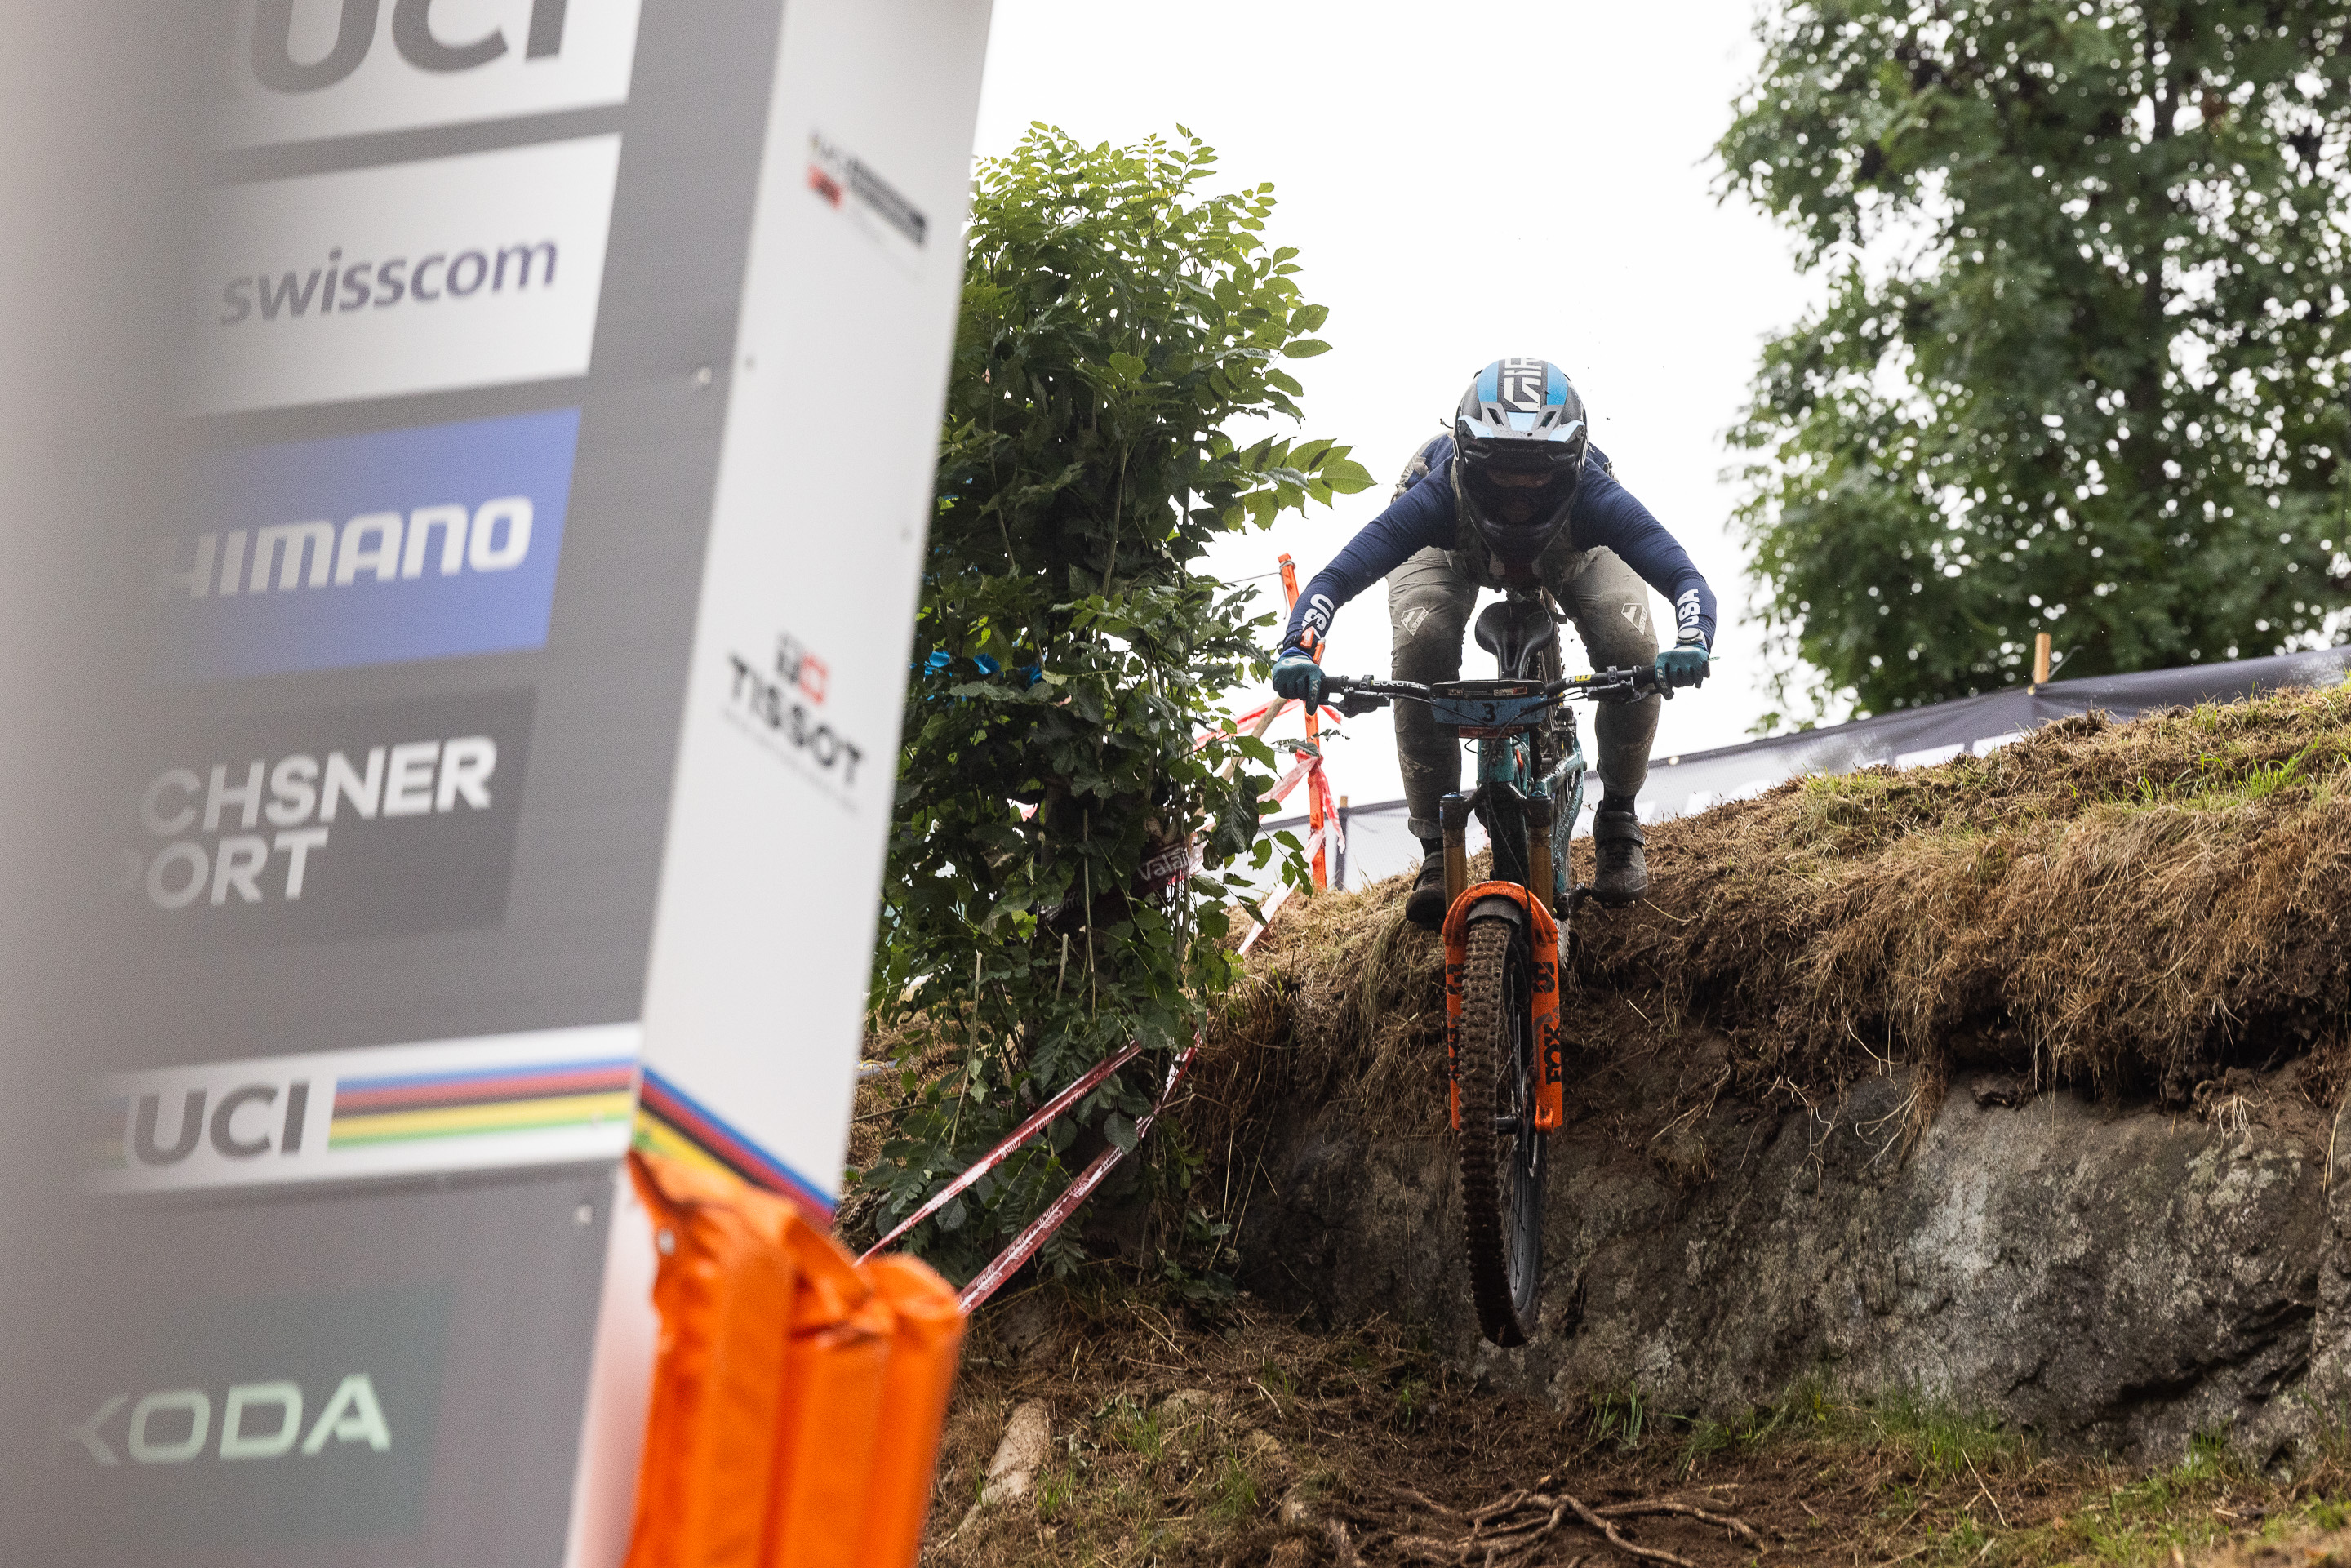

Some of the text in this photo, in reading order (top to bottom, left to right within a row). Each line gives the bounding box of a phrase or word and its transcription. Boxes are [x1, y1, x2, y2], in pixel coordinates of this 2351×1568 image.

[220, 238, 558, 325] swisscom
[167, 496, 535, 599] HIMANO
[1677, 589, 1700, 633] USA
[727, 651, 864, 785] TISSOT
[1481, 703, 1496, 722] 3
[139, 736, 498, 837] CHSNER
[1544, 1024, 1562, 1085] FOX
[133, 1079, 311, 1167] UCI
[69, 1375, 391, 1468] KODA
